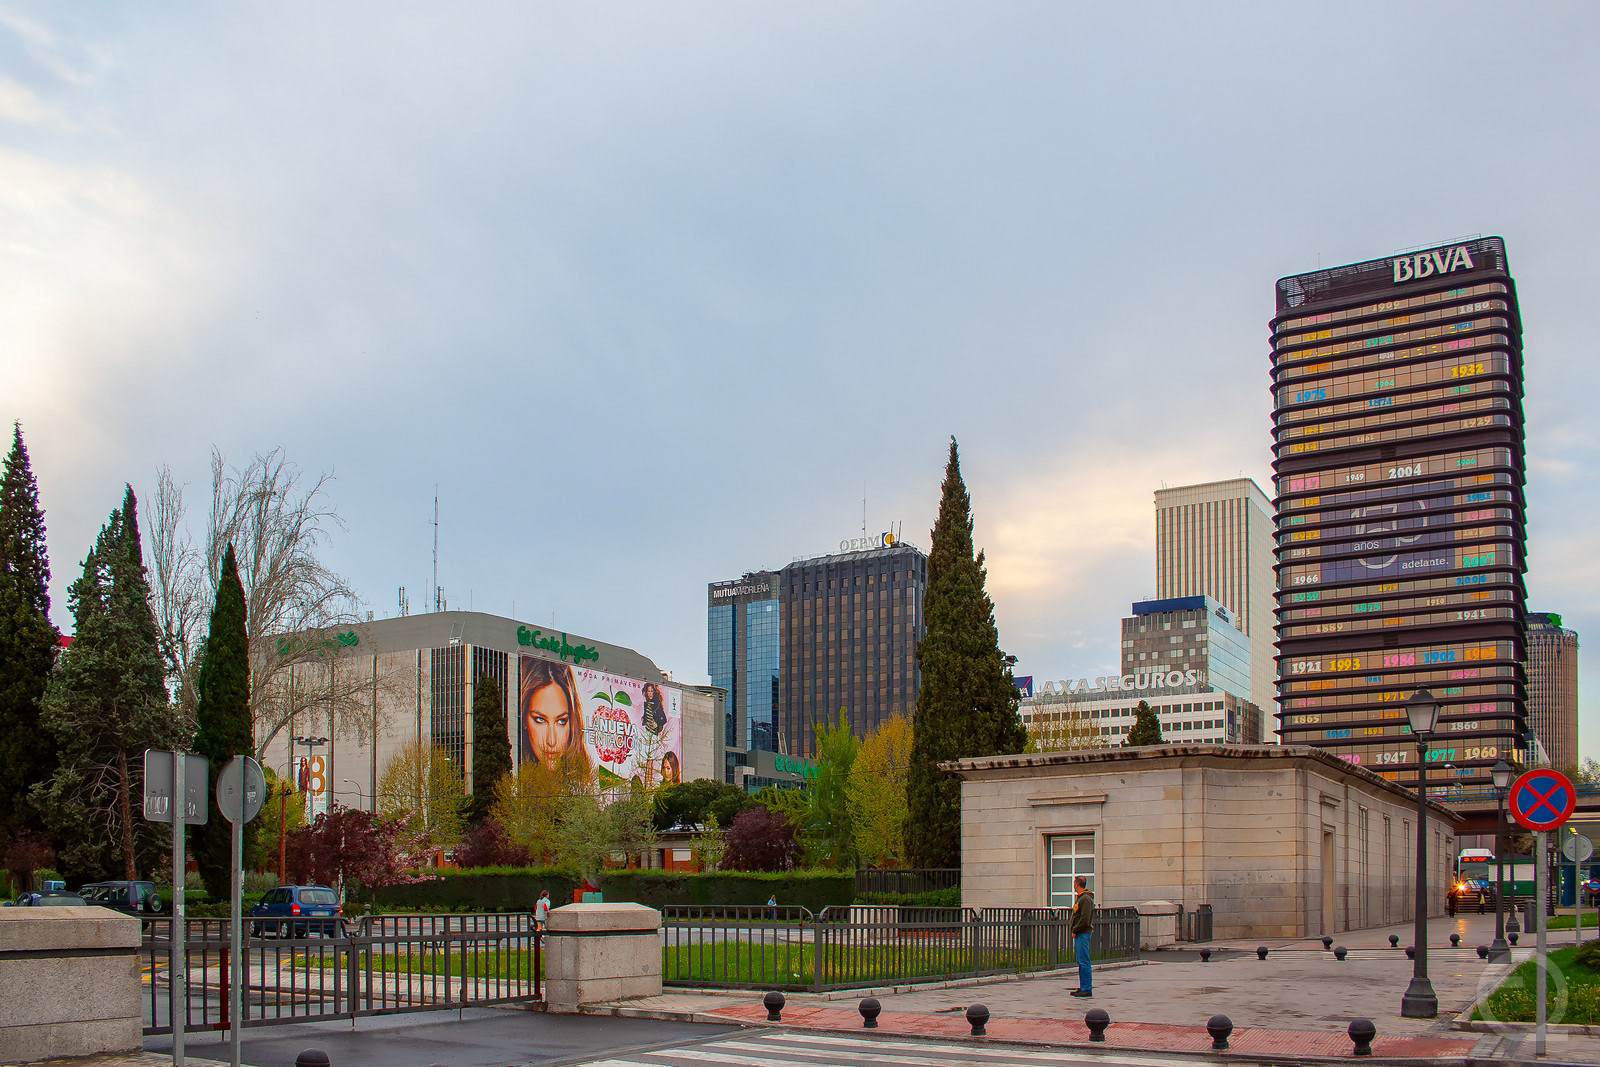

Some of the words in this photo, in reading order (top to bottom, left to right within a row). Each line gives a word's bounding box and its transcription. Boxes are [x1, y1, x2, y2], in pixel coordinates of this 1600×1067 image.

[1394, 247, 1474, 283] BBVA
[1451, 363, 1484, 378] 1932
[1296, 388, 1327, 403] 1975
[1346, 473, 1364, 482] 1949
[1388, 463, 1421, 478] 2004
[1463, 553, 1495, 568] 2007
[1295, 575, 1318, 584] 1966
[1457, 609, 1487, 620] 1941
[1329, 657, 1361, 672] 1993
[1383, 653, 1415, 667] 1986
[1423, 650, 1456, 665] 1902
[1292, 661, 1321, 674] 1921
[577, 670, 598, 680] MODA
[601, 675, 642, 689] PRIMAVERA
[1041, 678, 1091, 696] AXA
[1095, 669, 1197, 693] SEGUROS
[1450, 721, 1478, 731] 1860
[1376, 752, 1407, 764] 1947
[1425, 750, 1455, 762] 1977
[1465, 747, 1497, 759] 1960
